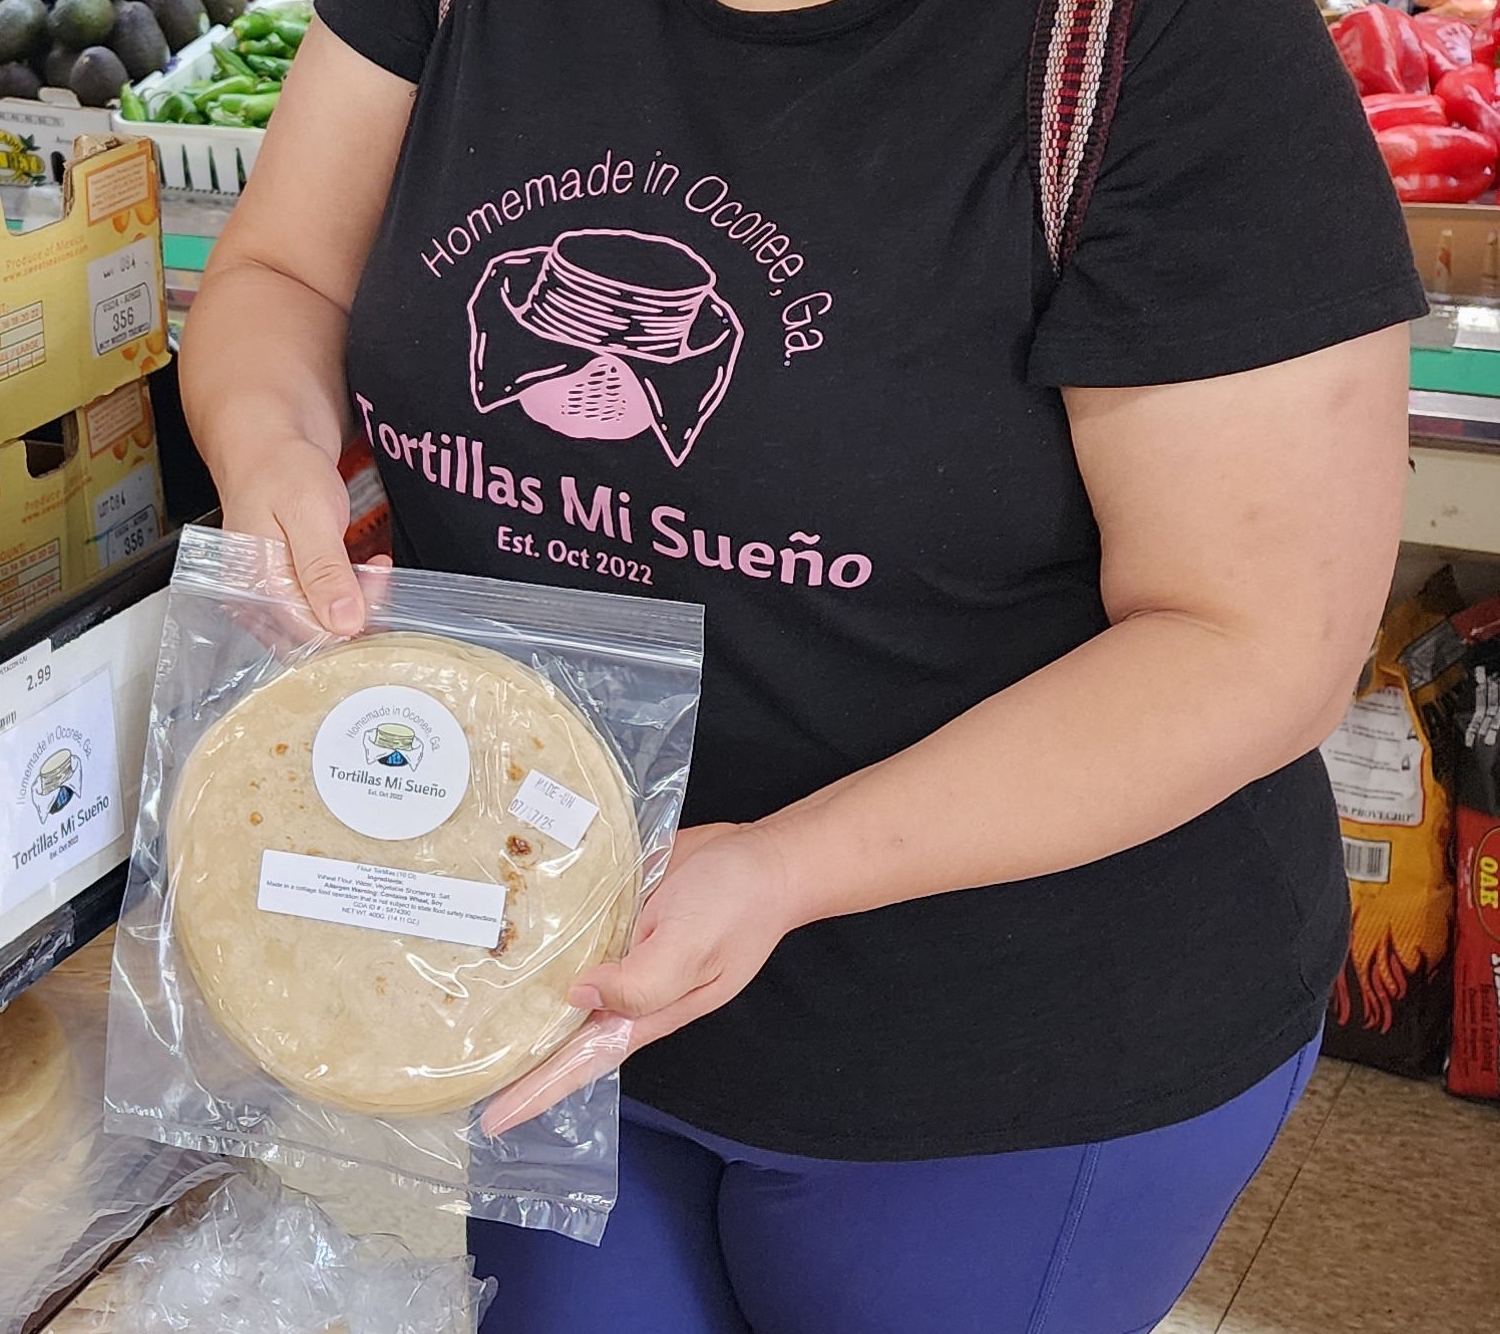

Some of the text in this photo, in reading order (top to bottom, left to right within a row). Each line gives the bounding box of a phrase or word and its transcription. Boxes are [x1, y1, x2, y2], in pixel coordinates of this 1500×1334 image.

[421, 149, 834, 367] Homemade in Oconee, Ga.
[113, 307, 135, 333] 356
[354, 391, 874, 589] Tortillas Mi Sueño
[124, 529, 145, 556] 356
[495, 525, 655, 586] Est. Oct 2022
[26, 664, 51, 692] 2.99
[346, 705, 391, 740] Homemade
[392, 705, 401, 717] in
[16, 738, 47, 807] Homemade
[329, 765, 448, 800] Tortillas Mi Sueño
[12, 793, 110, 871] Tortillas Mi Sueño
[266, 879, 283, 889] Made
[295, 885, 317, 895] cottage
[331, 890, 359, 901] operation
[389, 900, 410, 911] subject
[446, 909, 464, 920] safety
[380, 890, 408, 902] Contains
[1479, 856, 1499, 909] OAK
